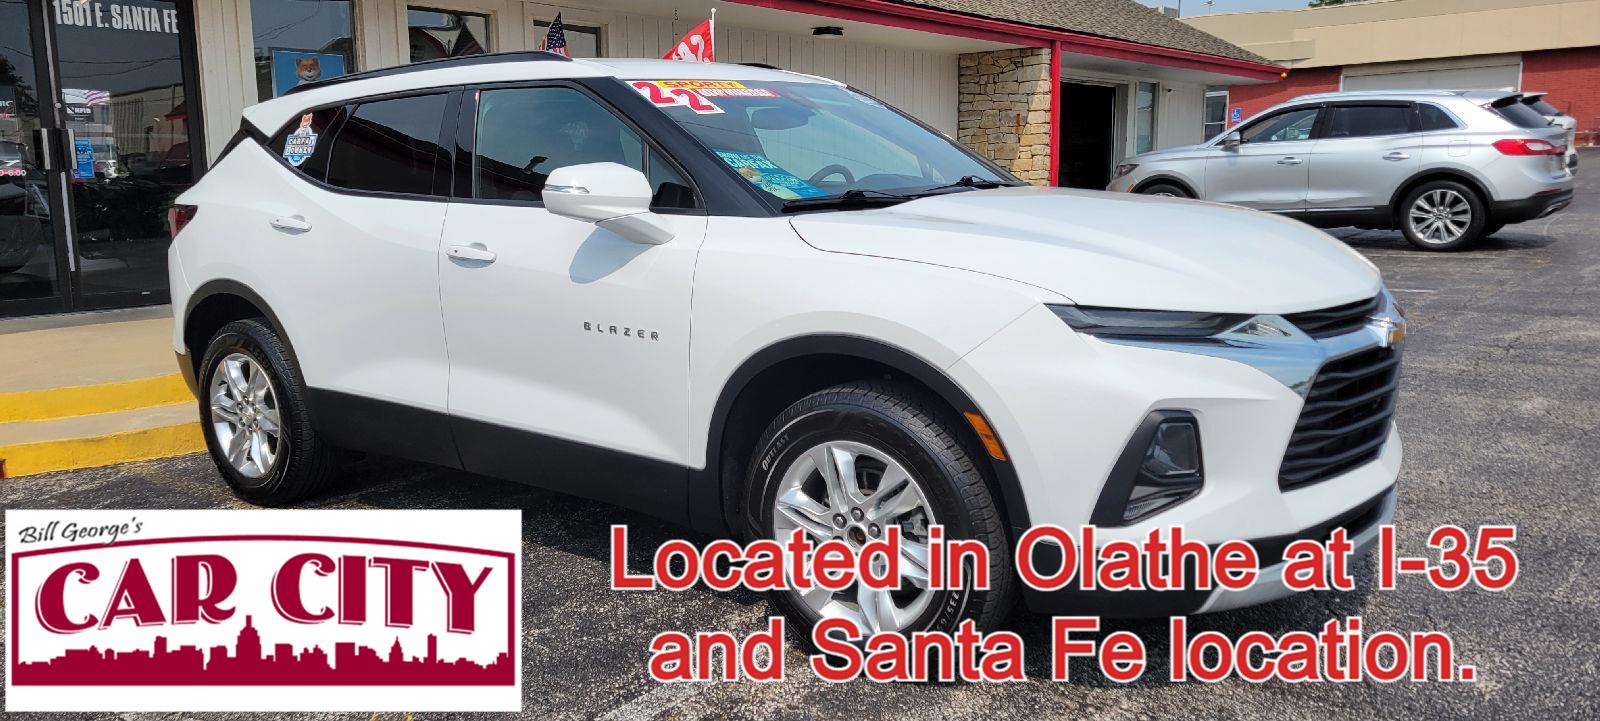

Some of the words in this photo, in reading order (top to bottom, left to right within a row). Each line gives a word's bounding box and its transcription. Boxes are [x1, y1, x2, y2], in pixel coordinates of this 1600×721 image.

[53, 0, 92, 26] 1501
[95, 3, 109, 28] E.
[110, 4, 161, 33] SANTA
[163, 9, 179, 33] FE
[632, 81, 715, 111] 22
[664, 81, 737, 89] SPORTY
[583, 321, 659, 341] BLAZER
[761, 433, 789, 471] OUTLAST
